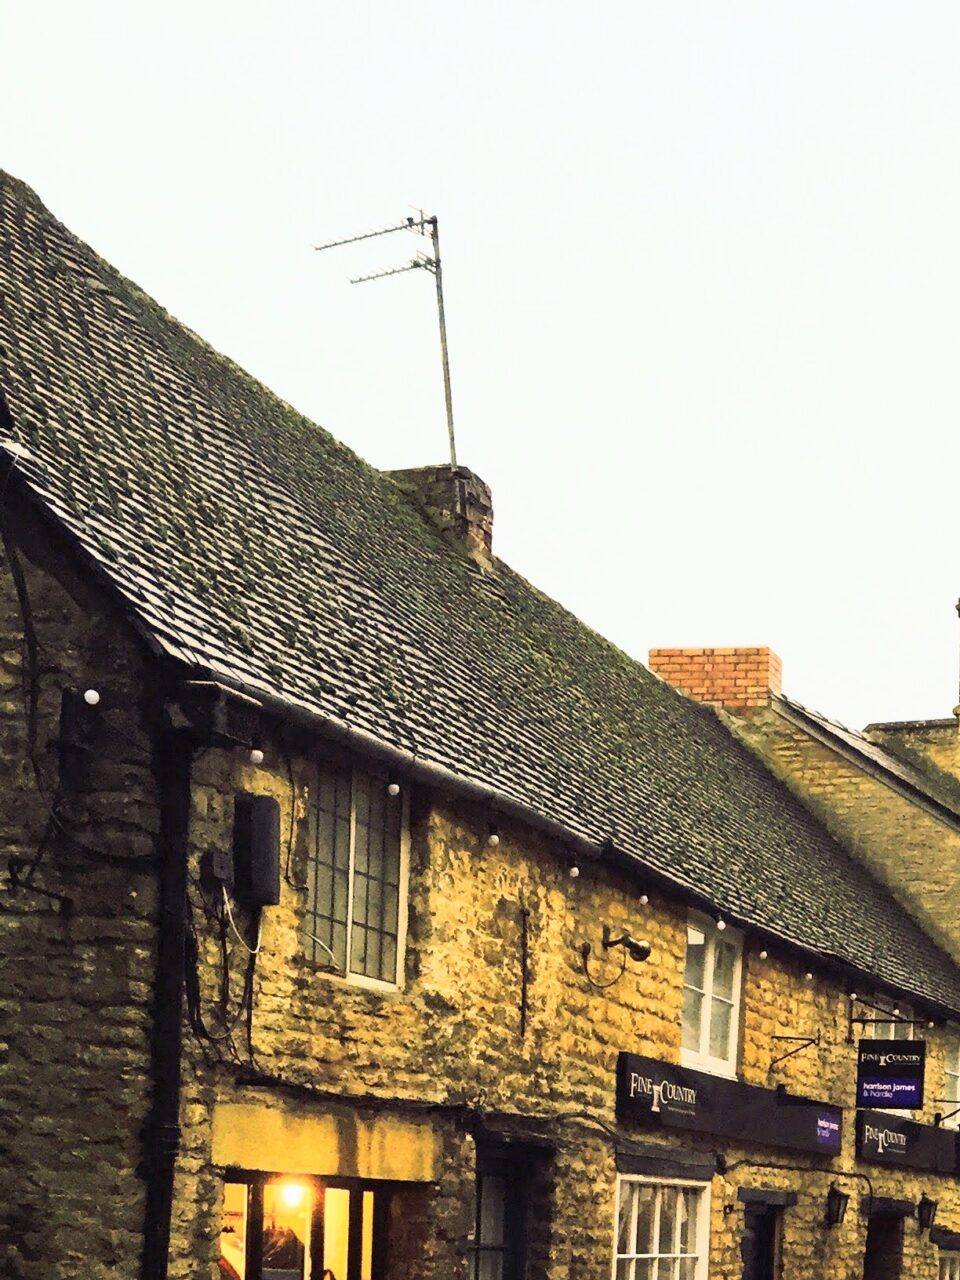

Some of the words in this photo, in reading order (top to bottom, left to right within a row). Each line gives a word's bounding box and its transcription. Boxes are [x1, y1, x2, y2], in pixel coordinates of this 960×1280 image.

[861, 1053, 879, 1062] FINE
[886, 1053, 920, 1063] COUNTRY
[629, 1072, 653, 1098] FINE
[660, 1080, 697, 1104] COUNTRY
[892, 1083, 916, 1092] james
